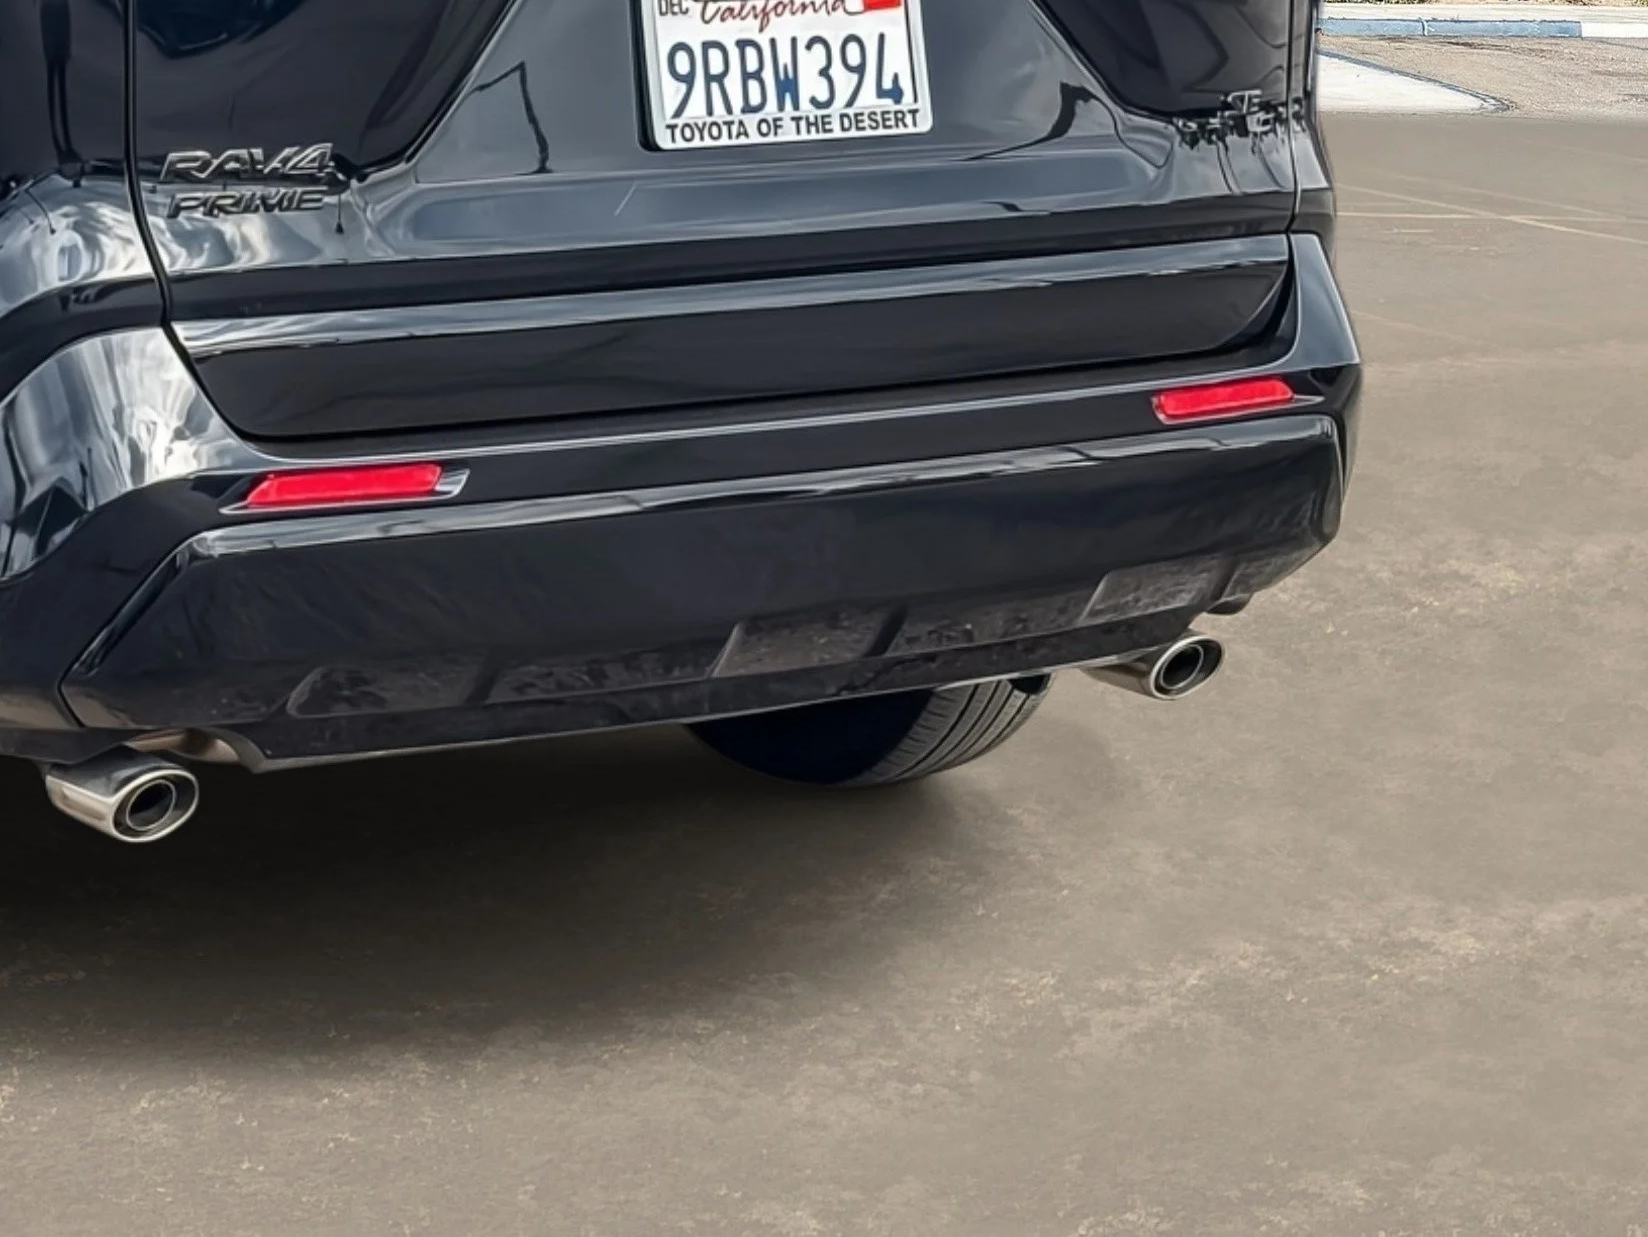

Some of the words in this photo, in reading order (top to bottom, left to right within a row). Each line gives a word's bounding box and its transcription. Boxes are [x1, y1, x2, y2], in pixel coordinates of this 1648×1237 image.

[667, 32, 905, 119] 9RBW394
[666, 119, 749, 144] TOYOTA
[756, 117, 785, 138] OF
[791, 114, 834, 136] THE
[840, 108, 921, 133] DESERT
[159, 142, 334, 183] RAV4
[166, 185, 330, 219] PRIME
